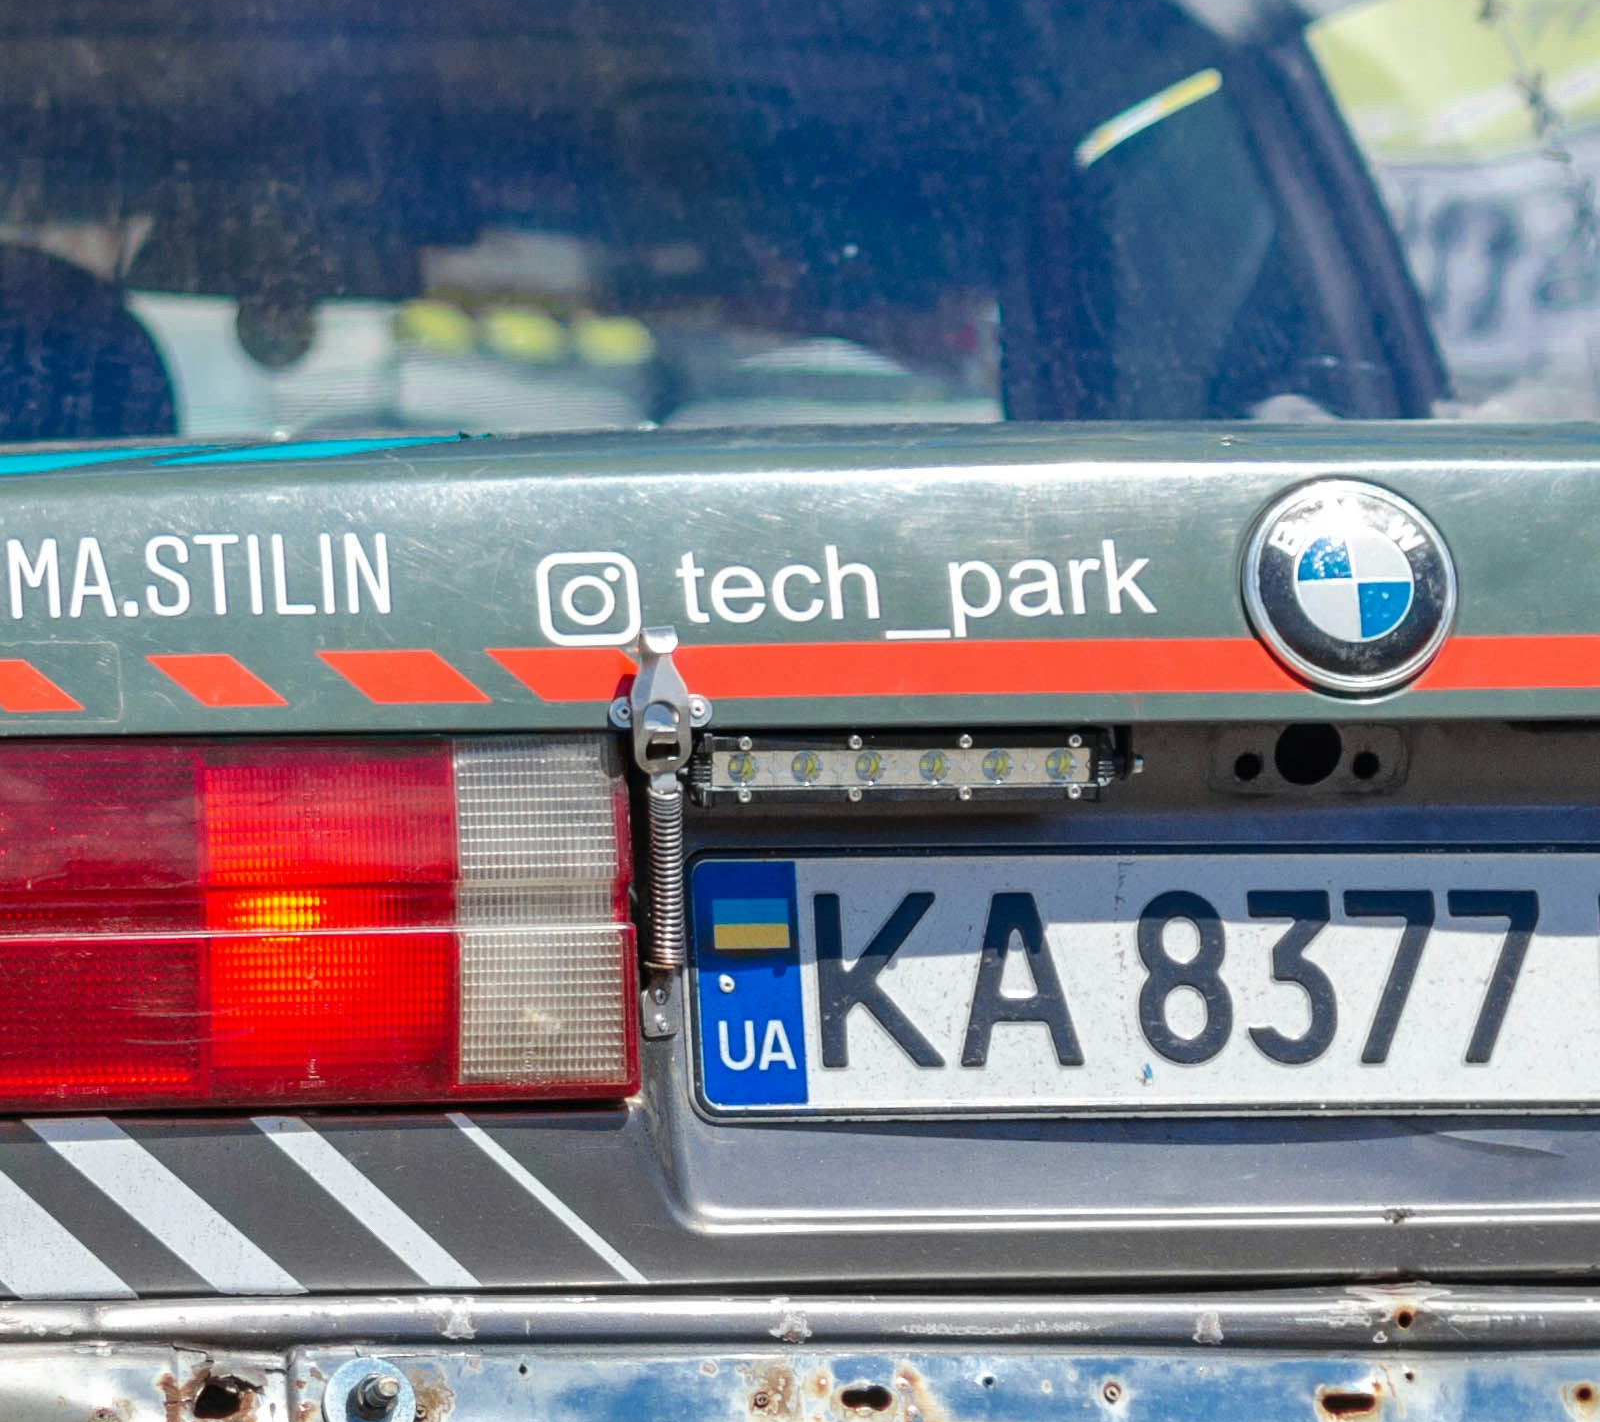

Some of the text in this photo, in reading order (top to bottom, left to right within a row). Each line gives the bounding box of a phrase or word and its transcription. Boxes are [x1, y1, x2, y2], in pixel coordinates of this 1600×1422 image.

[674, 538, 1159, 640] tech_park
[811, 889, 1084, 1069] KA
[1137, 889, 1541, 1065] 8377
[718, 1019, 797, 1072] UA
